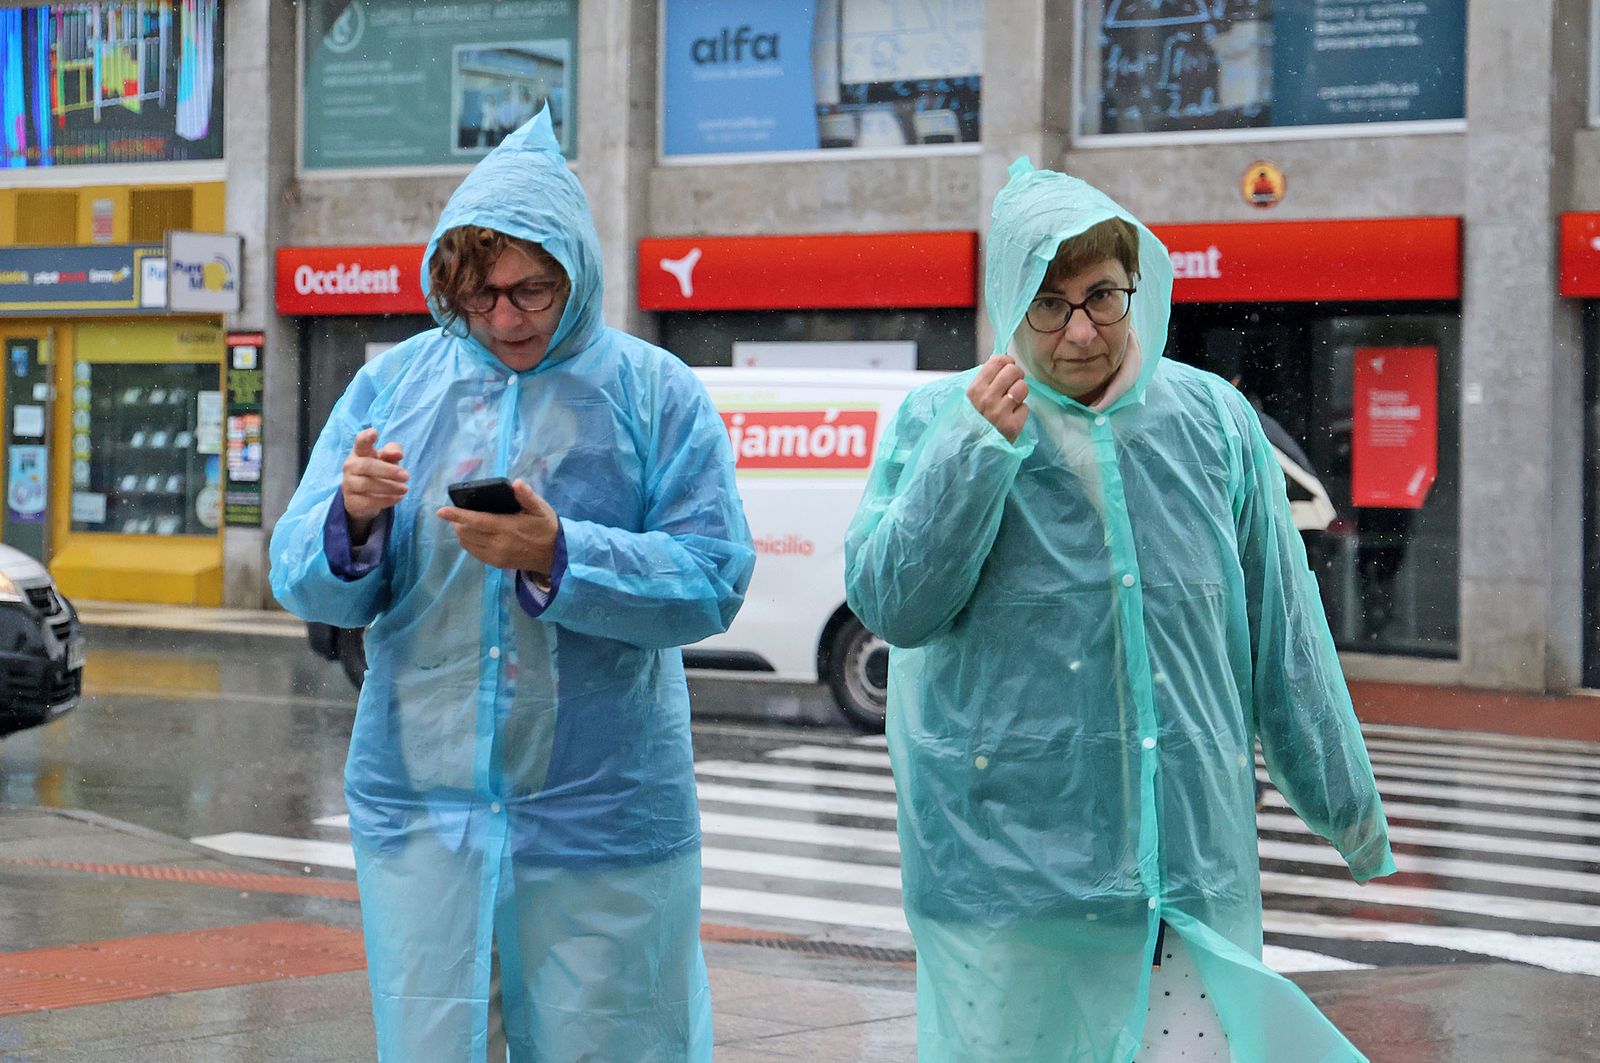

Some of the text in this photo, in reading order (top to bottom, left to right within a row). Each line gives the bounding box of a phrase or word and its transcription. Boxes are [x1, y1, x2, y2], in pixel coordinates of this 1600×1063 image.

[691, 26, 780, 66] alfa
[294, 263, 400, 295] Occident
[1170, 245, 1223, 279] ent
[730, 408, 868, 461] jamón
